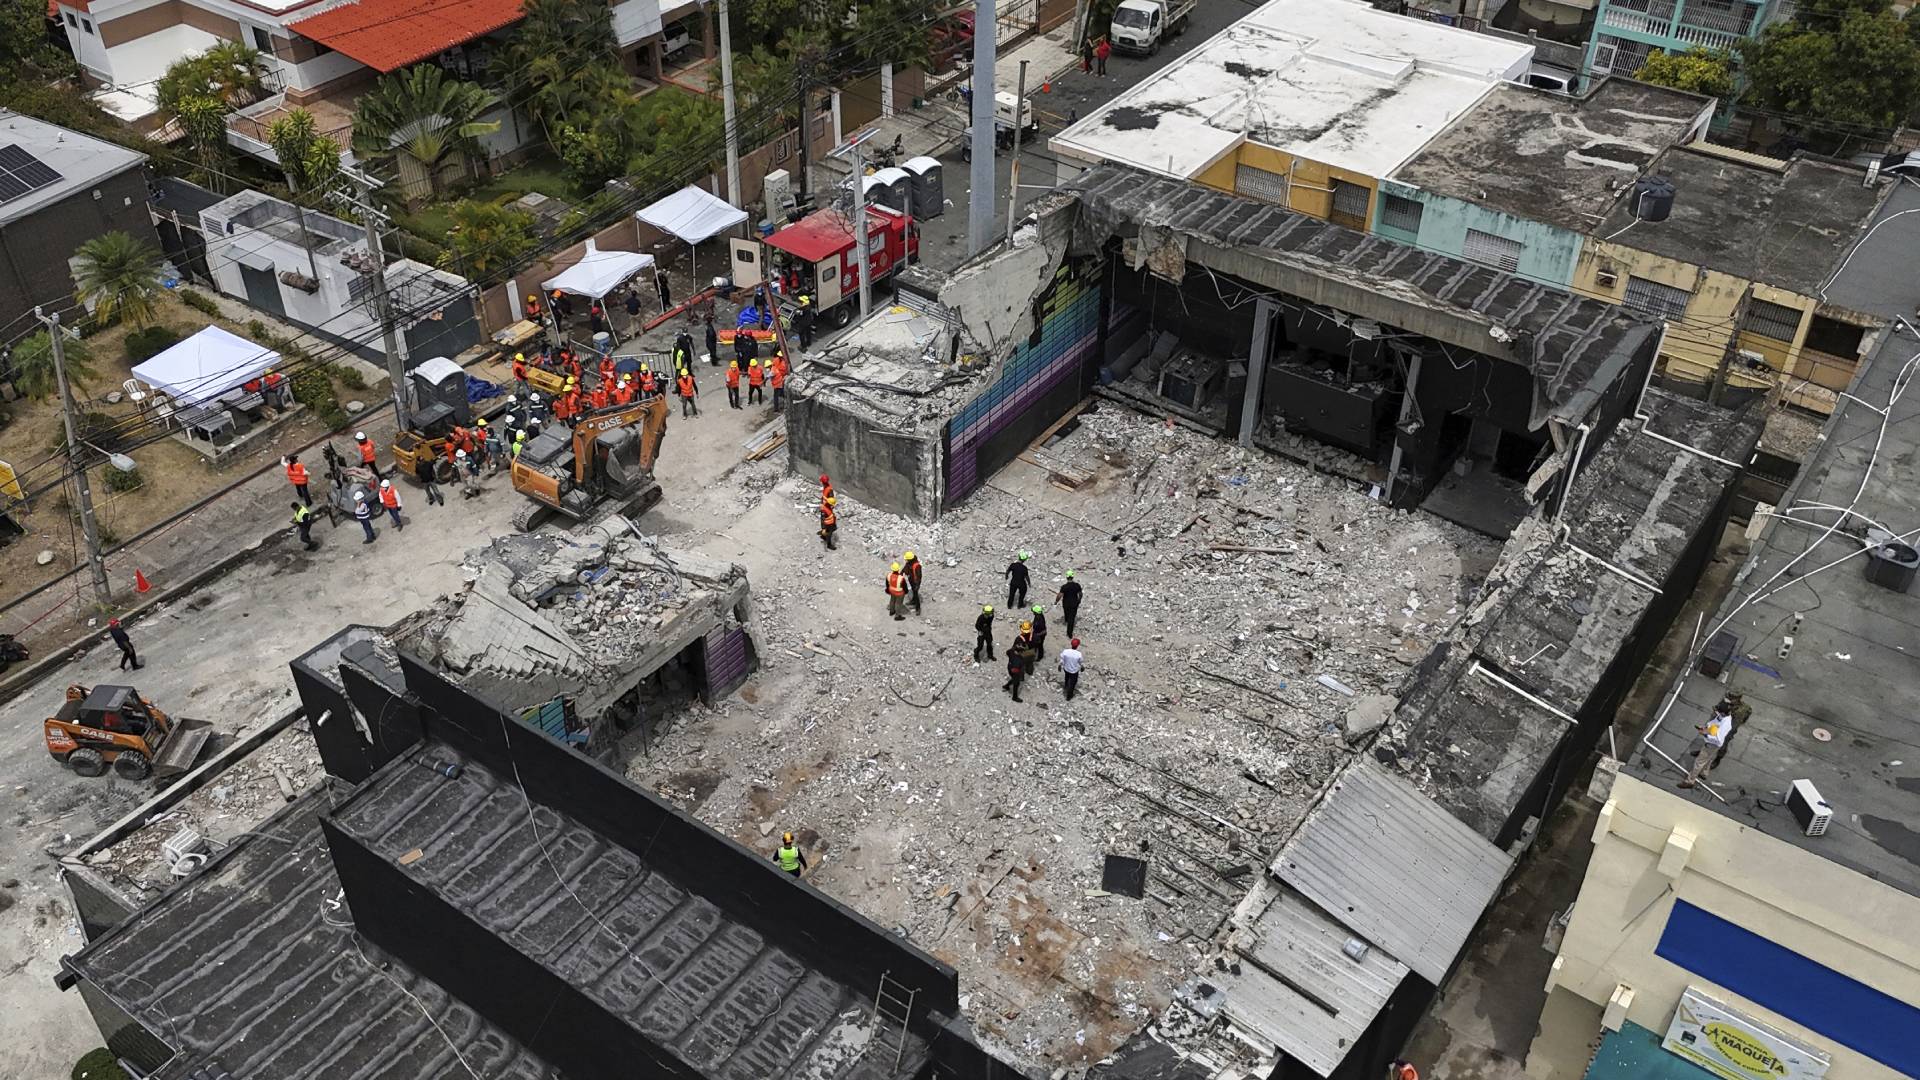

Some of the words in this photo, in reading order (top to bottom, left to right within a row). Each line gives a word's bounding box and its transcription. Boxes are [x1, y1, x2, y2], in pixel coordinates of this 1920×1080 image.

[598, 416, 623, 431] CASE
[80, 728, 114, 741] CASE
[1700, 1025, 1719, 1041] LA
[1721, 1036, 1785, 1074] MAQUETA
